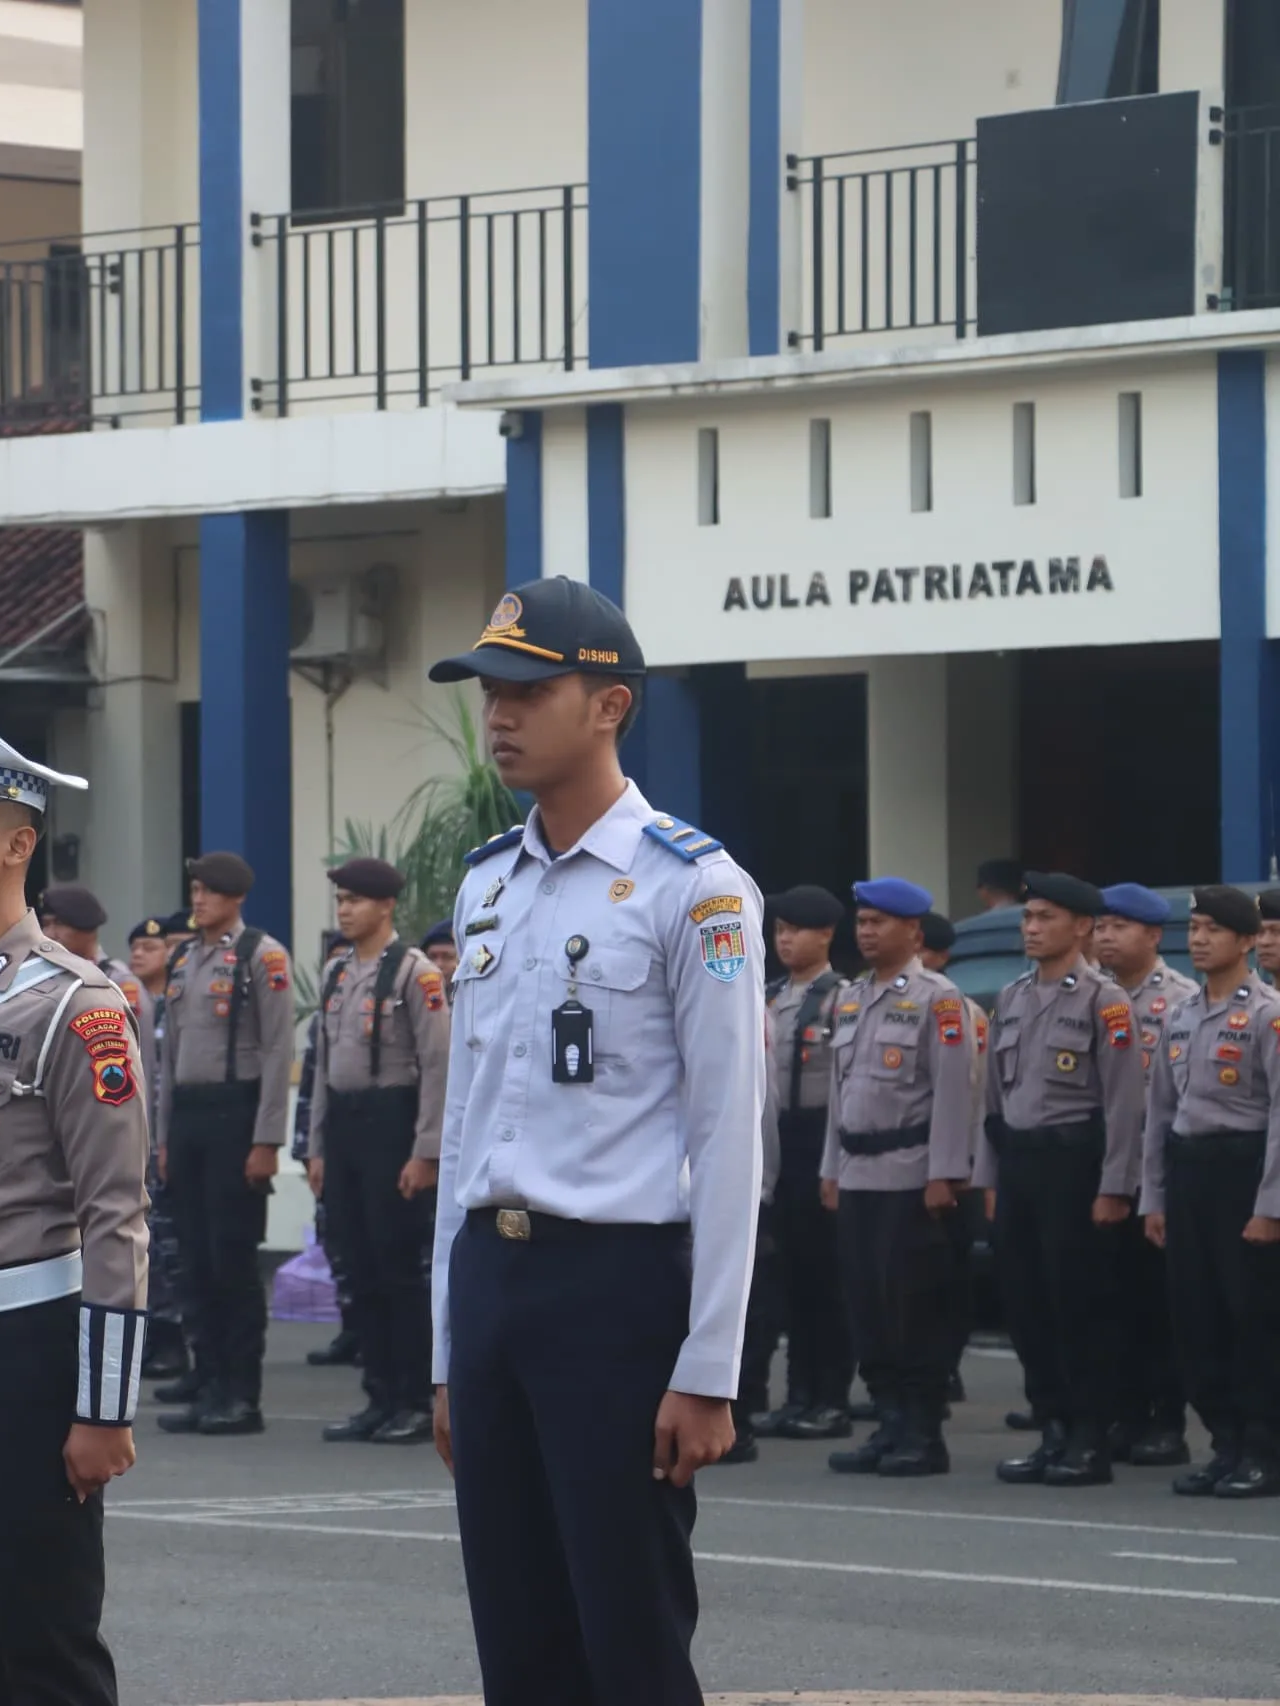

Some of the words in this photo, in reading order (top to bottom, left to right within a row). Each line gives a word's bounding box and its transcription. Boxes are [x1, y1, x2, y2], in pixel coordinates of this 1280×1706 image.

[723, 571, 832, 611] AULA
[848, 555, 1114, 605] PATRIATAMA
[578, 648, 619, 664] DISHUB
[75, 1011, 120, 1028] POLRESTA
[884, 1013, 920, 1026] POLRI
[85, 1024, 118, 1036] CILACAP
[1217, 1030, 1252, 1043] POLRI
